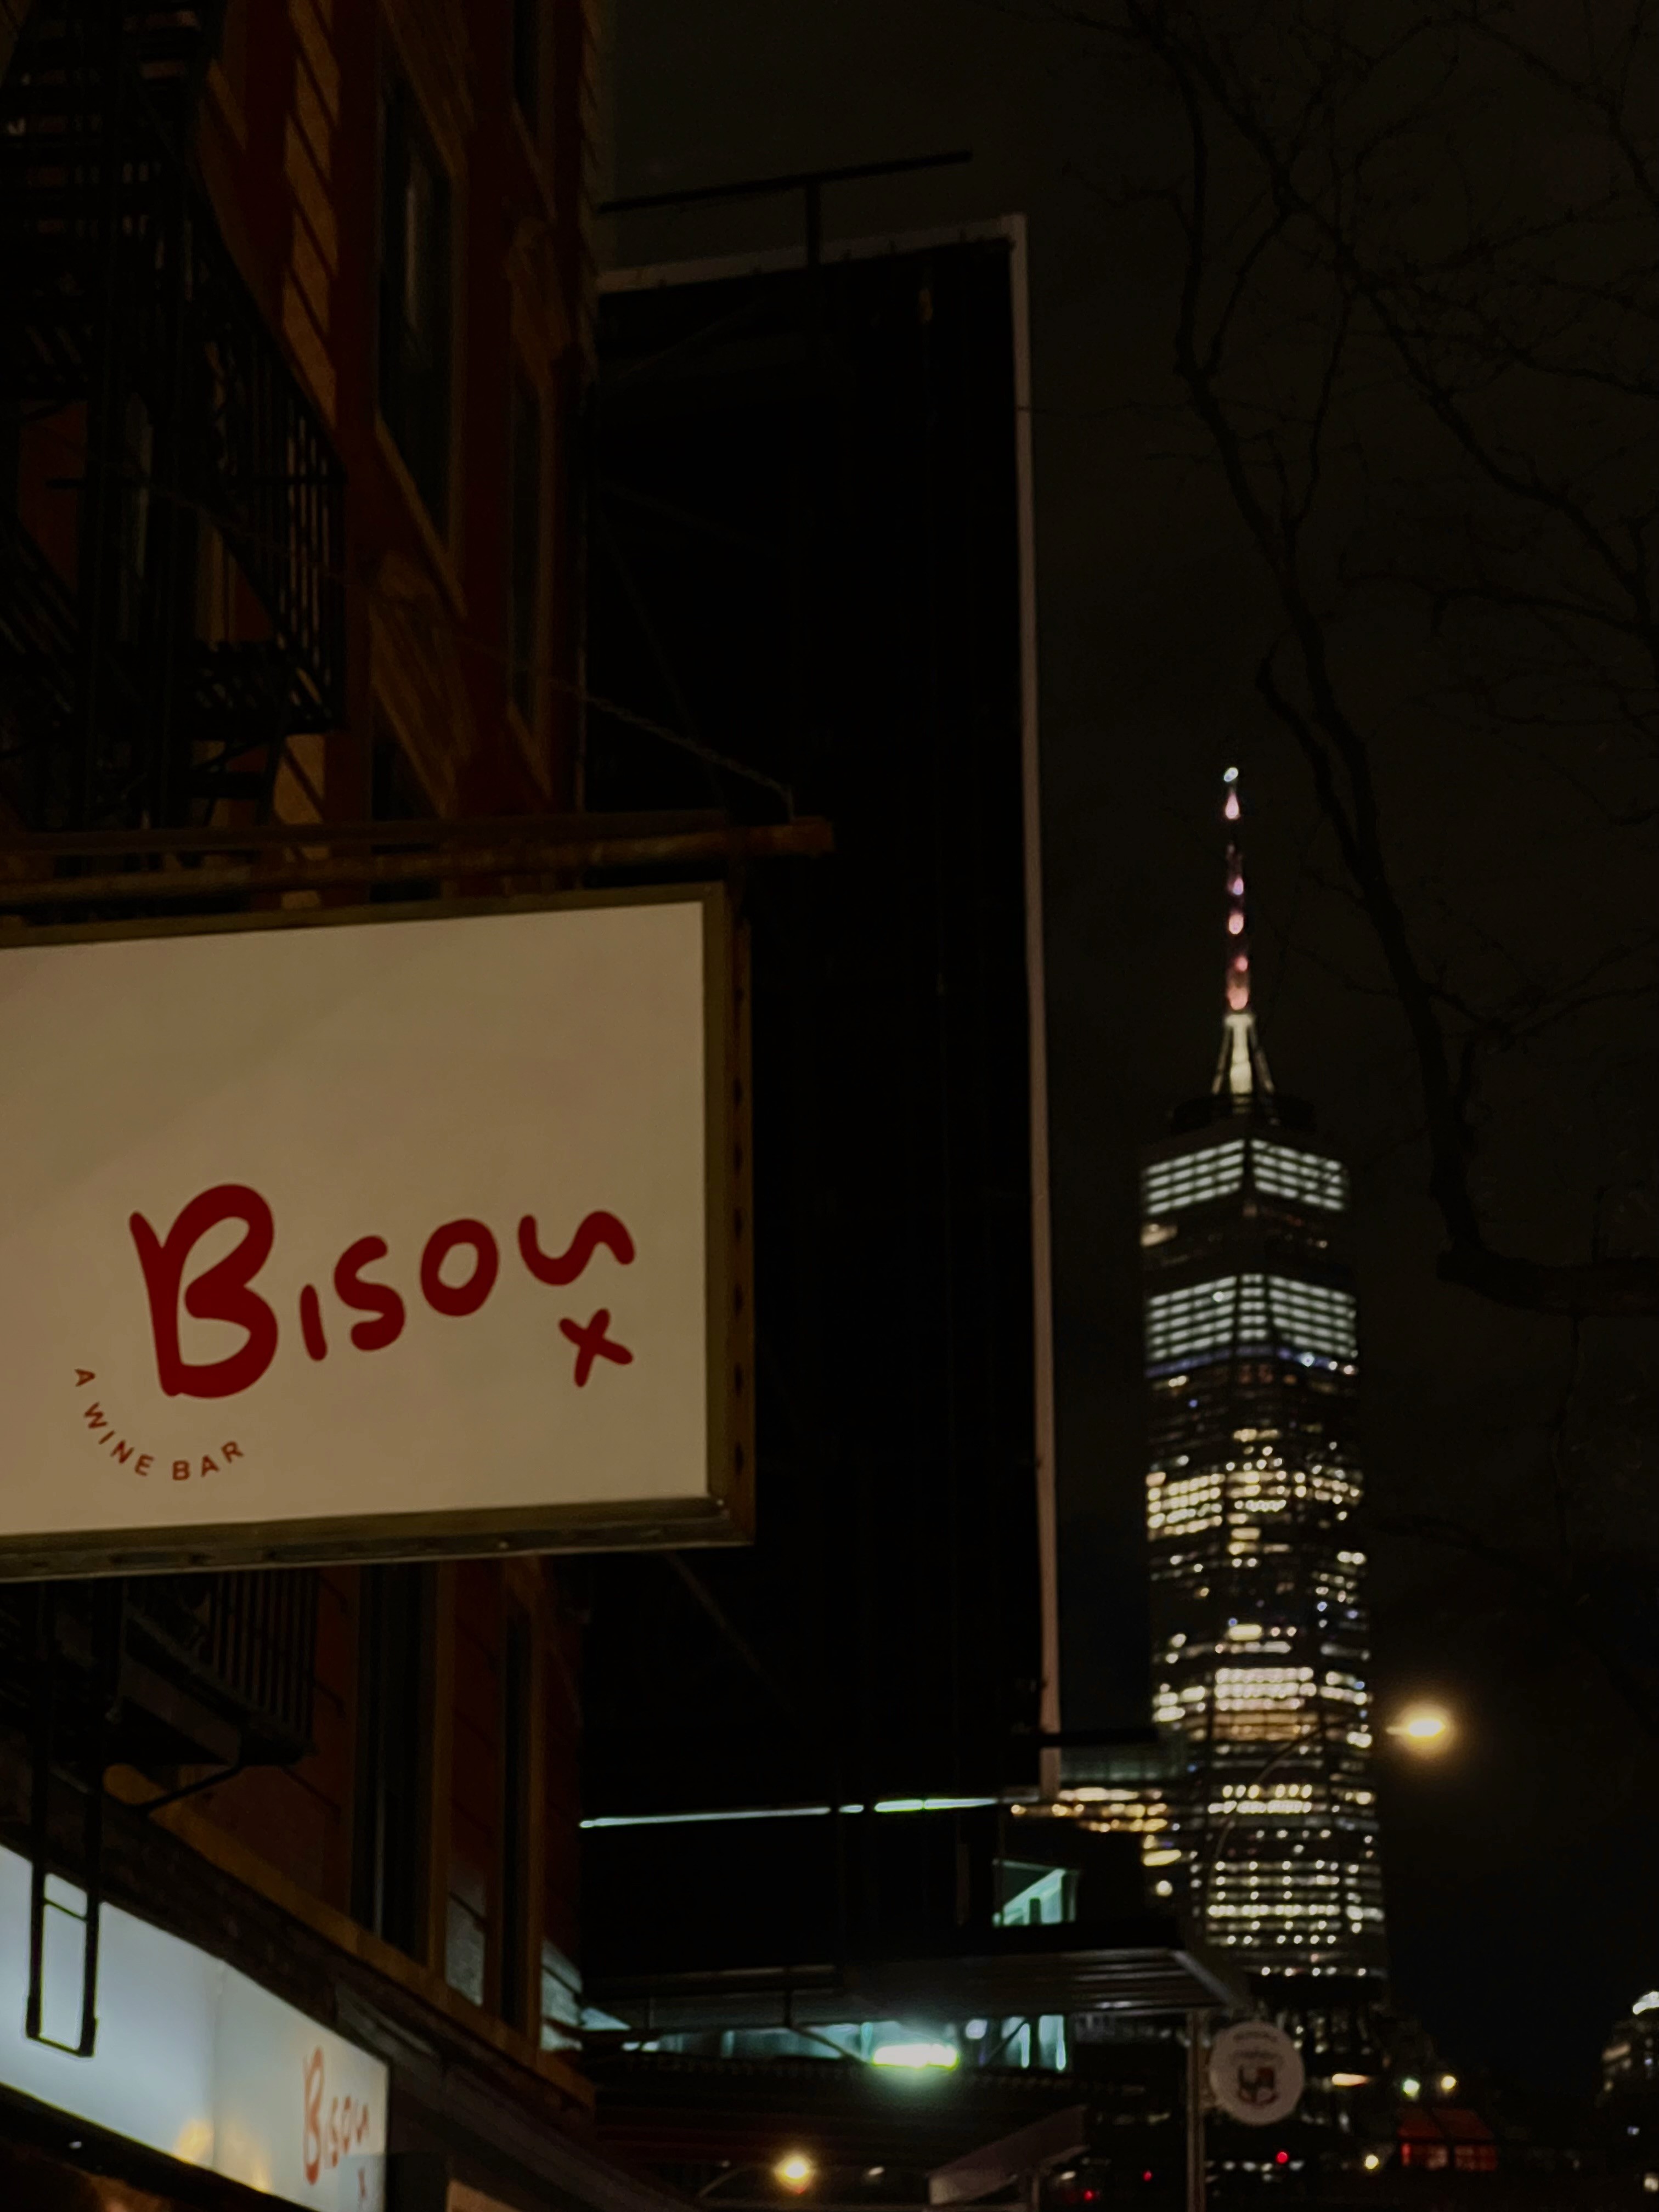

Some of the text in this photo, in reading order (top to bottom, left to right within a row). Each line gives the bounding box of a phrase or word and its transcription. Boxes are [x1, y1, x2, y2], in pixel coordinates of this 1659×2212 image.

[129, 1184, 635, 1398] Bisou
[75, 1369, 244, 1481] A WINE BAR
